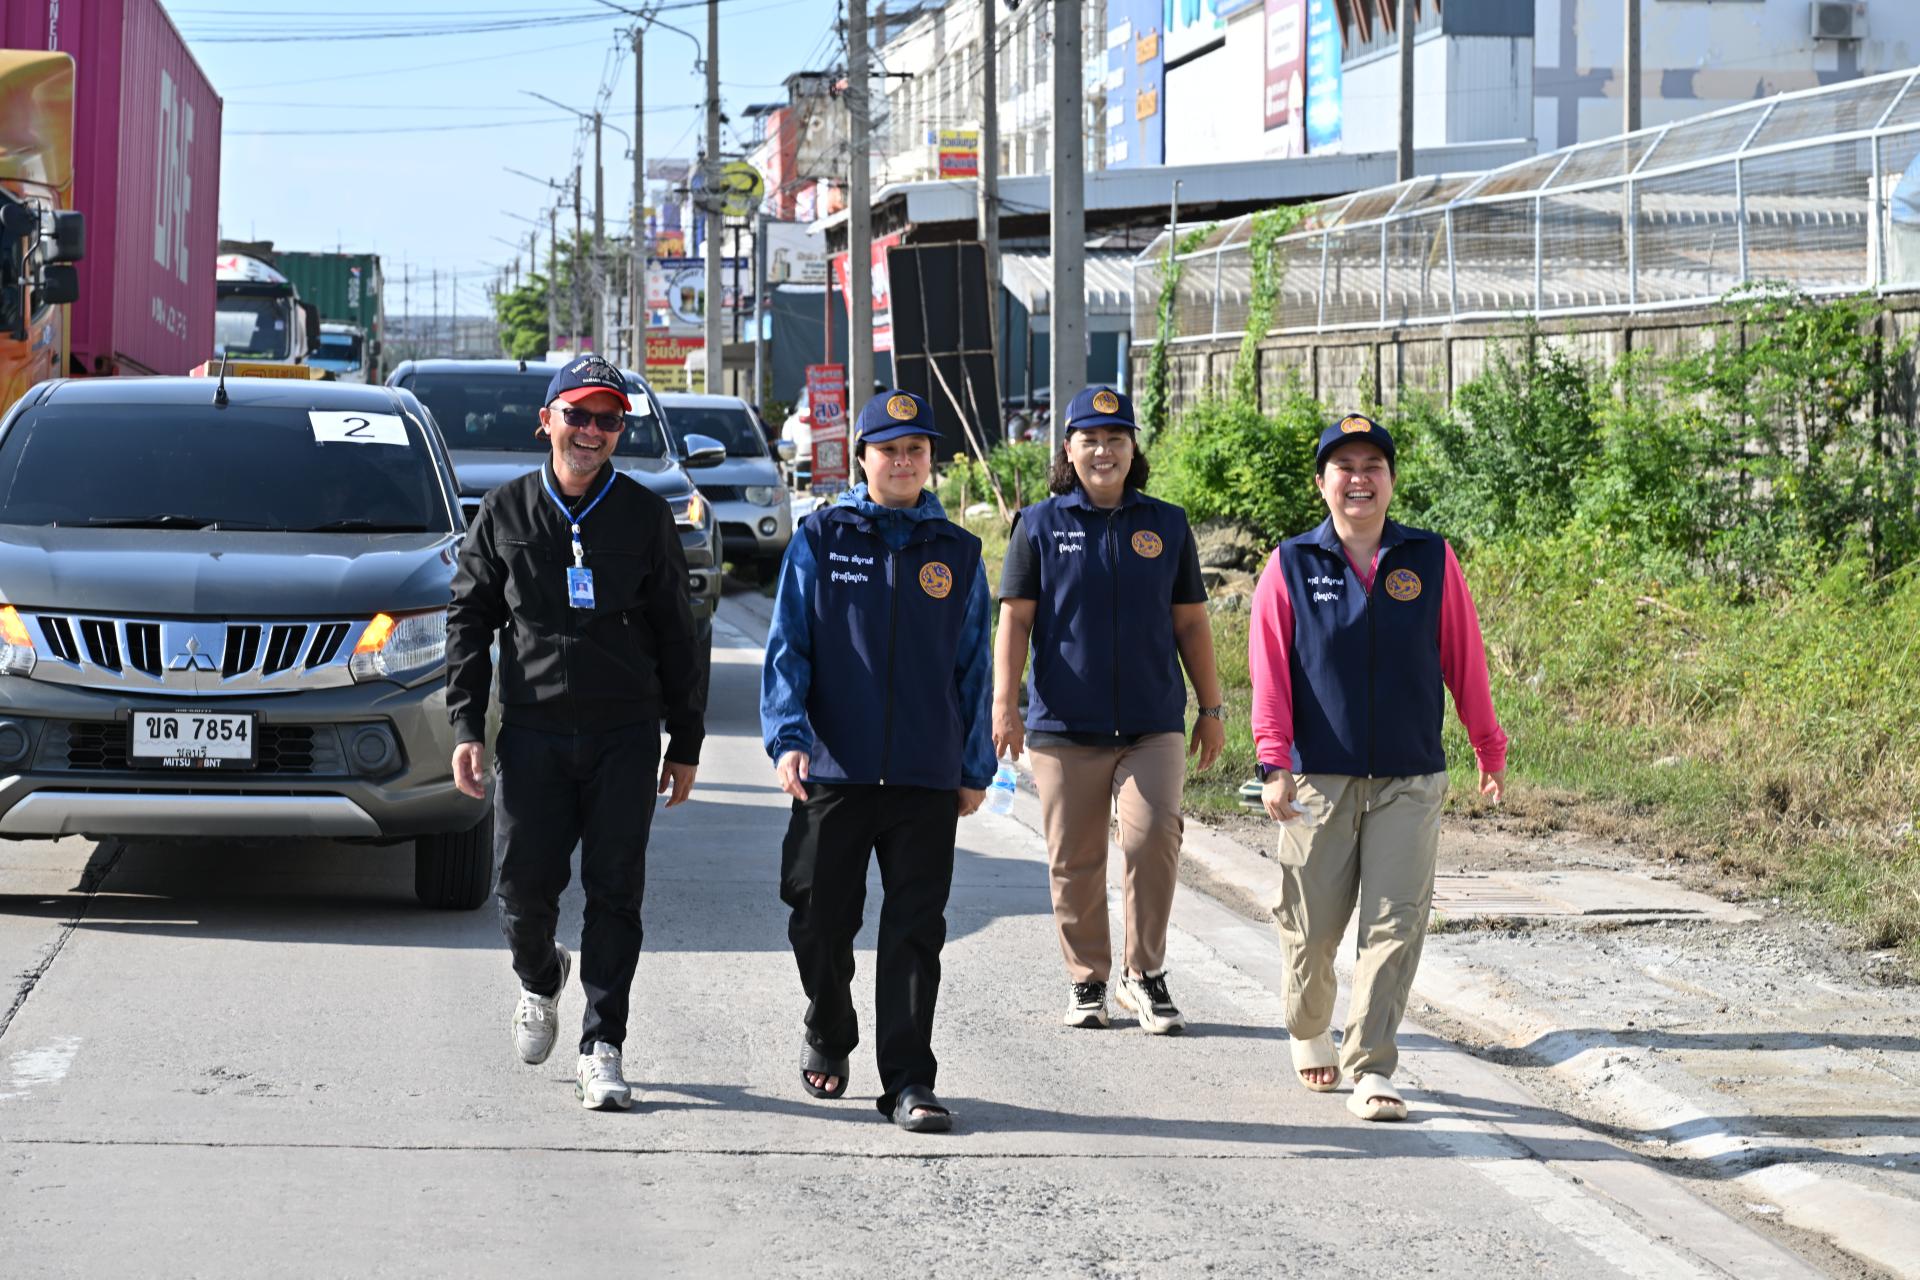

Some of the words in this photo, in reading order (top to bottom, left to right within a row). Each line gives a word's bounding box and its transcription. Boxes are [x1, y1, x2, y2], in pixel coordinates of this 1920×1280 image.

[48, 0, 60, 51] NEU
[153, 68, 195, 285] ONE
[343, 417, 375, 438] 2
[146, 717, 179, 740] ขล
[192, 718, 248, 742] 7854
[163, 758, 191, 767] MITSU
[203, 759, 221, 768] BNT
[176, 746, 207, 758] ชลบรี
